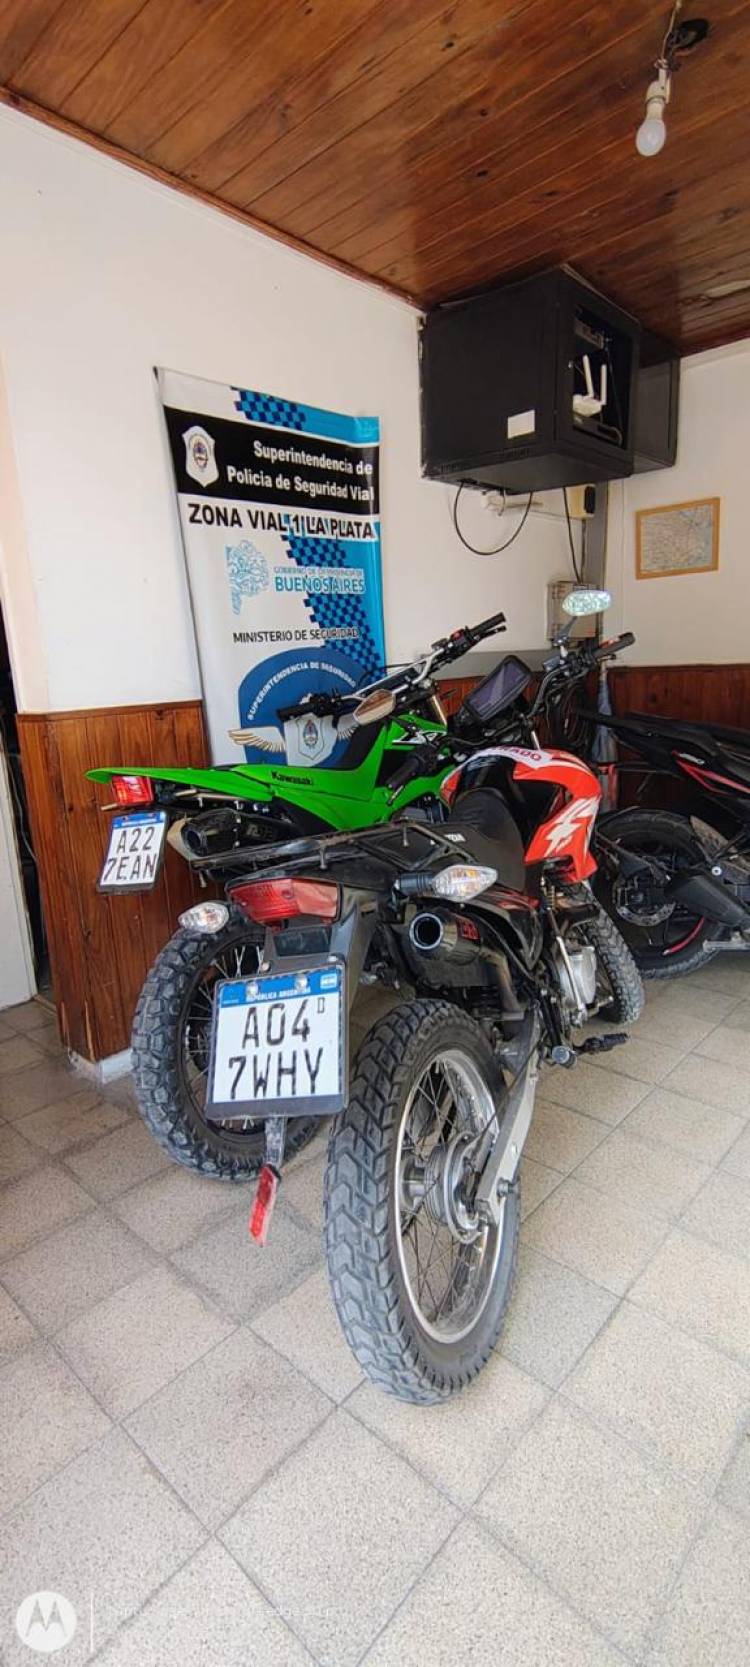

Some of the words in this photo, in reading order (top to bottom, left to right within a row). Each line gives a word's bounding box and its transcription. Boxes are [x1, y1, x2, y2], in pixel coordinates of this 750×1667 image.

[253, 440, 353, 475] Superintendencia
[356, 460, 373, 476] de
[275, 474, 291, 491] de
[294, 476, 349, 499] Seguridad
[350, 486, 375, 501] Vial
[188, 503, 243, 529] ZONA
[247, 509, 288, 532] VIAL
[292, 513, 300, 533] 1
[306, 516, 327, 536] LA
[330, 519, 376, 539] PLATA
[275, 576, 329, 592] BUENOS
[331, 577, 366, 593] AIRES
[232, 629, 293, 643] MINISTERIO
[295, 629, 308, 641] DE
[309, 627, 359, 641] SEGURIDAD
[247, 661, 309, 721] SUPERINTENDENCIA
[271, 770, 314, 786] Kawasaki
[116, 826, 156, 853] A22
[102, 854, 158, 881] 7EAN
[241, 999, 310, 1049] A04
[228, 1047, 324, 1100] 7WHY
